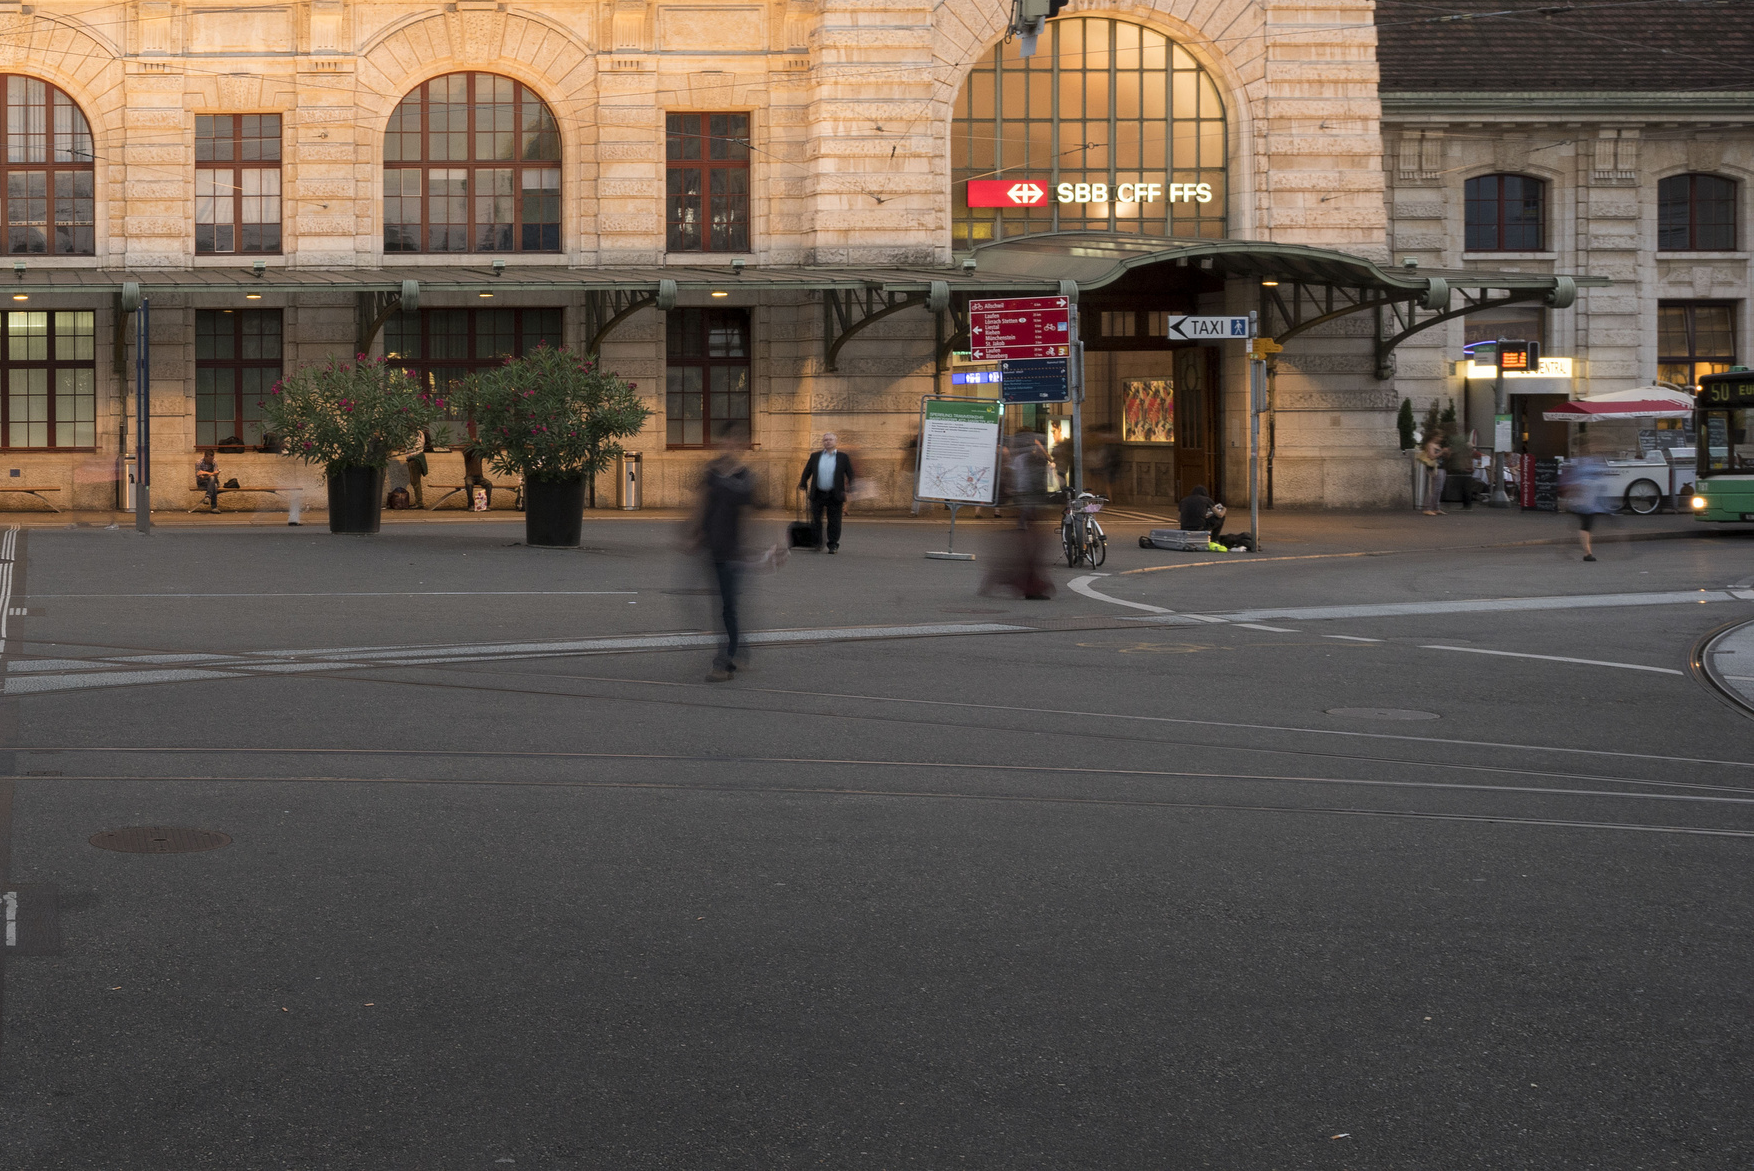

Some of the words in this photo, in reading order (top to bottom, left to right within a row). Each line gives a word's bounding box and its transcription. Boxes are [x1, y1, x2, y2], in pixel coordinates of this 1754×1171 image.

[1057, 182, 1109, 203] SBB
[1117, 182, 1161, 203] CFF
[1169, 182, 1213, 203] FFS
[1191, 320, 1224, 335] TAXI
[1058, 348, 1065, 356] 3
[1711, 383, 1730, 401] 50
